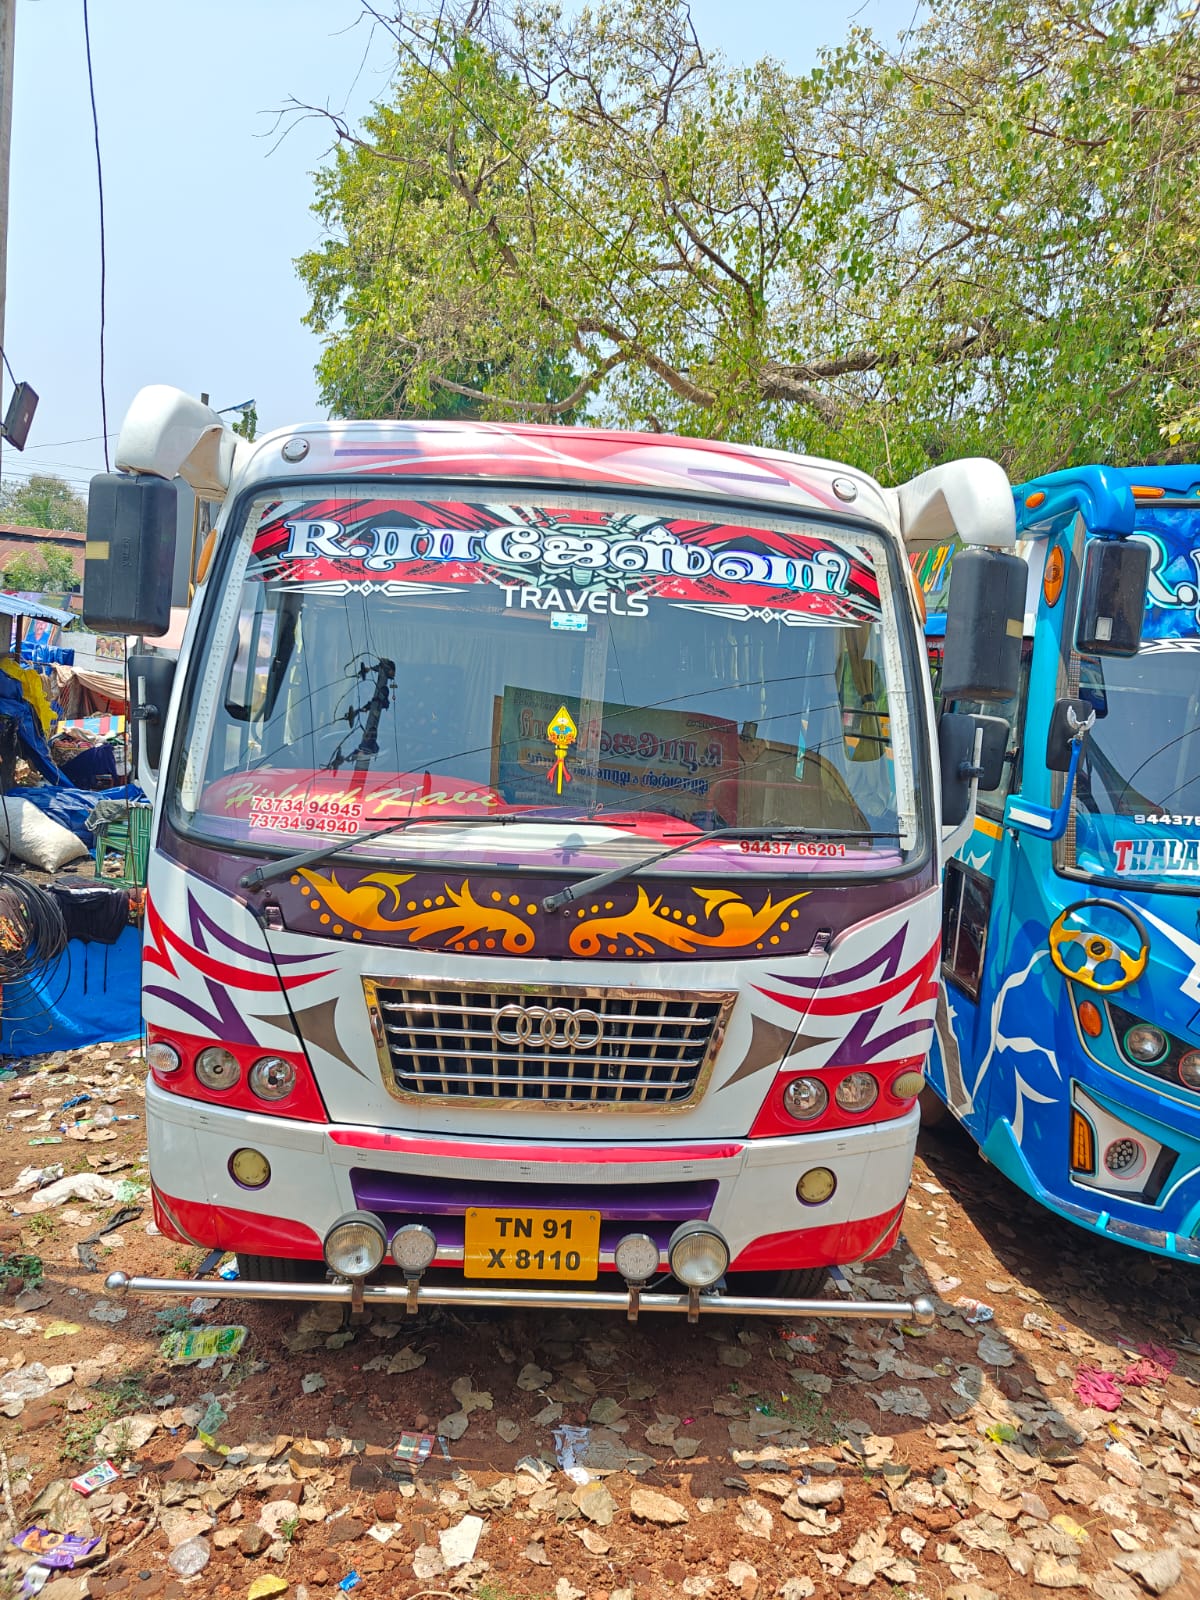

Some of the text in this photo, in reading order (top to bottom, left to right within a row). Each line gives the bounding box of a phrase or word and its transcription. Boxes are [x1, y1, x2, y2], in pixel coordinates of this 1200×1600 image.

[499, 585, 649, 617] TRAVELS
[253, 796, 362, 817] 73734 94945
[249, 813, 359, 834] 73734 94940
[740, 840, 846, 857] 94437 66201
[495, 1217, 572, 1239] TN 91
[487, 1248, 580, 1271] X 8110
